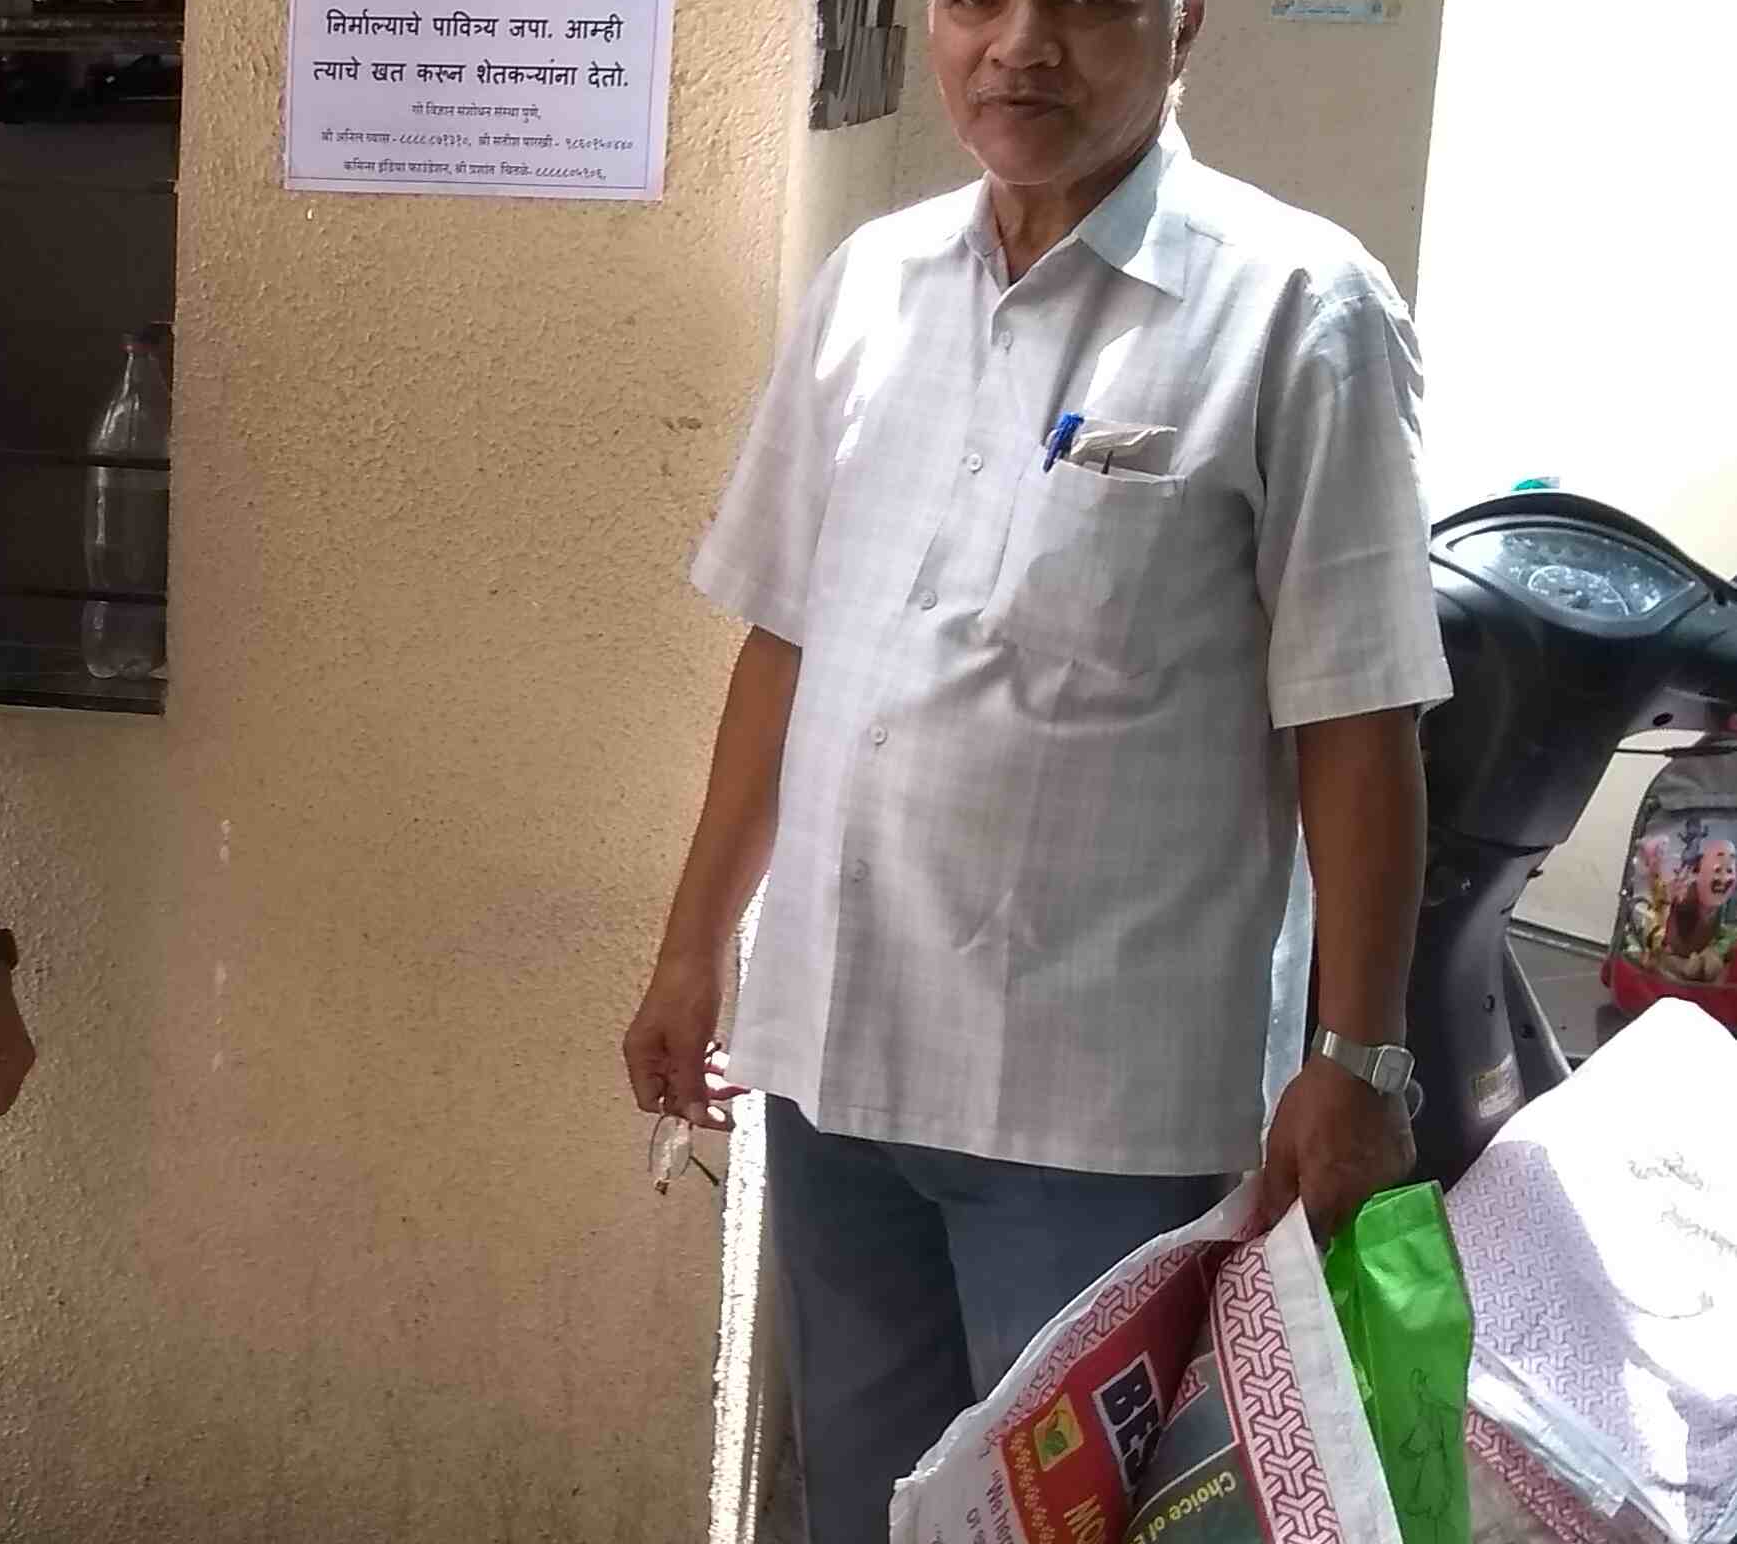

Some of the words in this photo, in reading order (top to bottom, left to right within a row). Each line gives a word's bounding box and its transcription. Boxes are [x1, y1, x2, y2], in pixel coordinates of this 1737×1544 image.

[325, 8, 422, 37] निर्माल्याचे
[509, 18, 553, 39] जपा.
[564, 14, 624, 42] आम्ही
[313, 56, 361, 82] त्याचे
[371, 62, 406, 83] खत
[588, 61, 629, 88] देतो.
[1165, 1470, 1239, 1522] Choice
